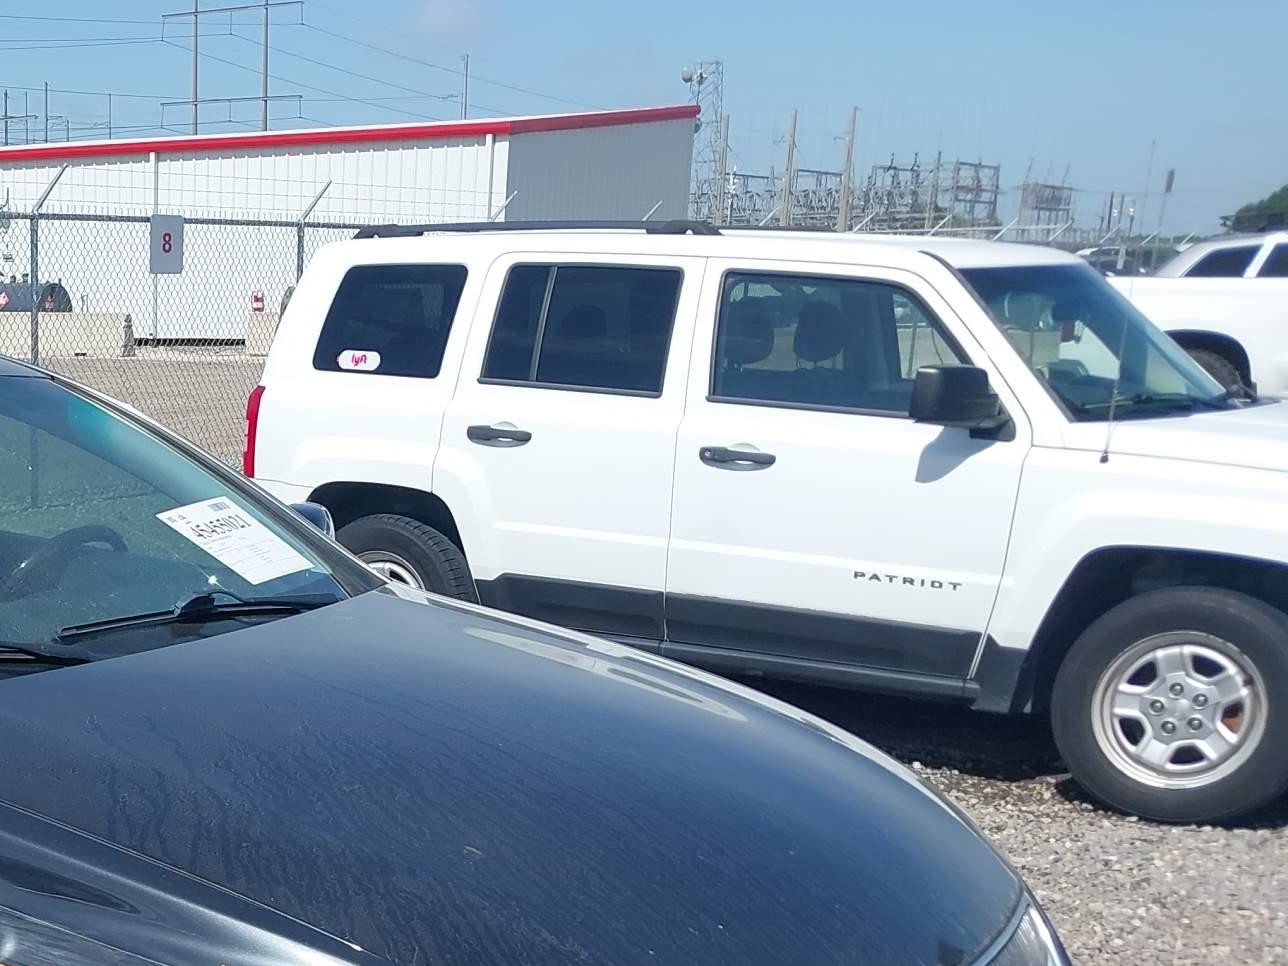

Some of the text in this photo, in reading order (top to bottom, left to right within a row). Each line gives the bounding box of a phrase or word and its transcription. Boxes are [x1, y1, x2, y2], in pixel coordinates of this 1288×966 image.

[162, 232, 172, 254] 8
[351, 353, 368, 367] lyft
[189, 514, 252, 539] 45455021
[853, 570, 963, 591] PATRIOT
